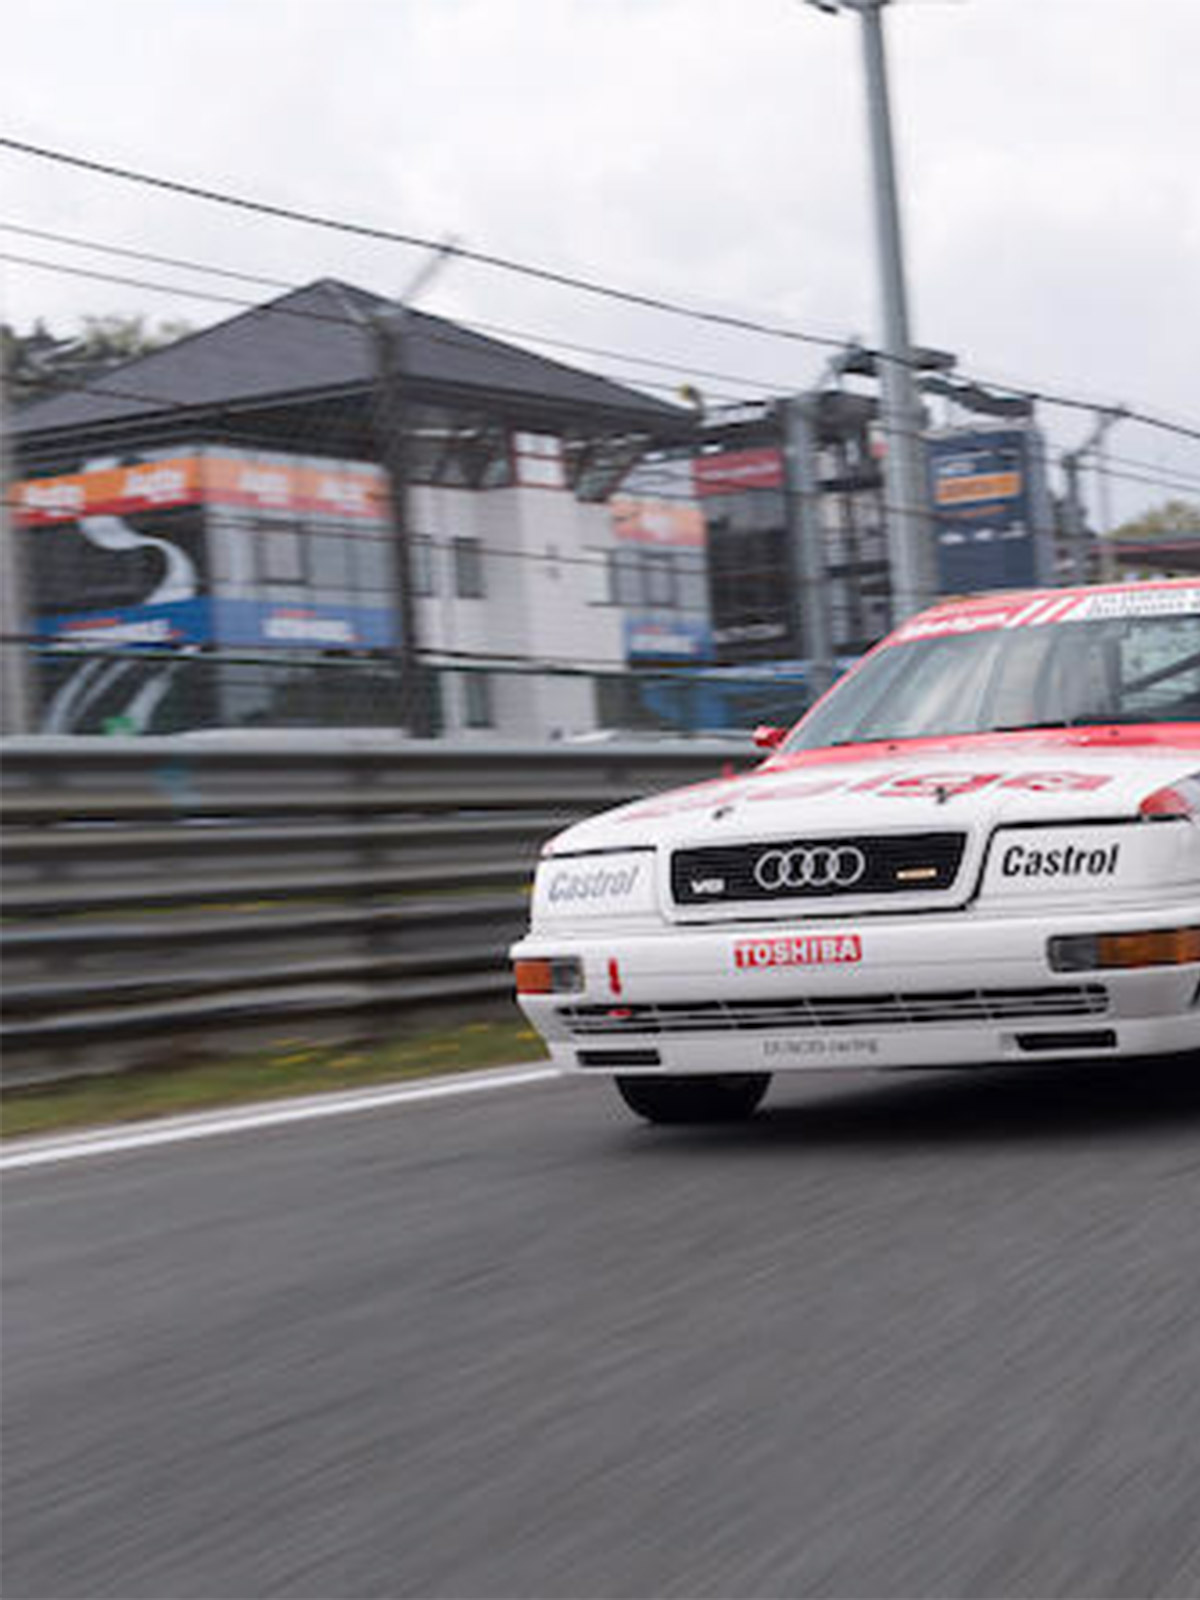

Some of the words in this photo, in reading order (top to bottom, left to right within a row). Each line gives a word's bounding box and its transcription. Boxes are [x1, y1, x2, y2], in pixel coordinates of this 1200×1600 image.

[1002, 843, 1120, 877] Castrol
[548, 865, 640, 902] Castrol
[738, 938, 858, 965] TOSHIBA
